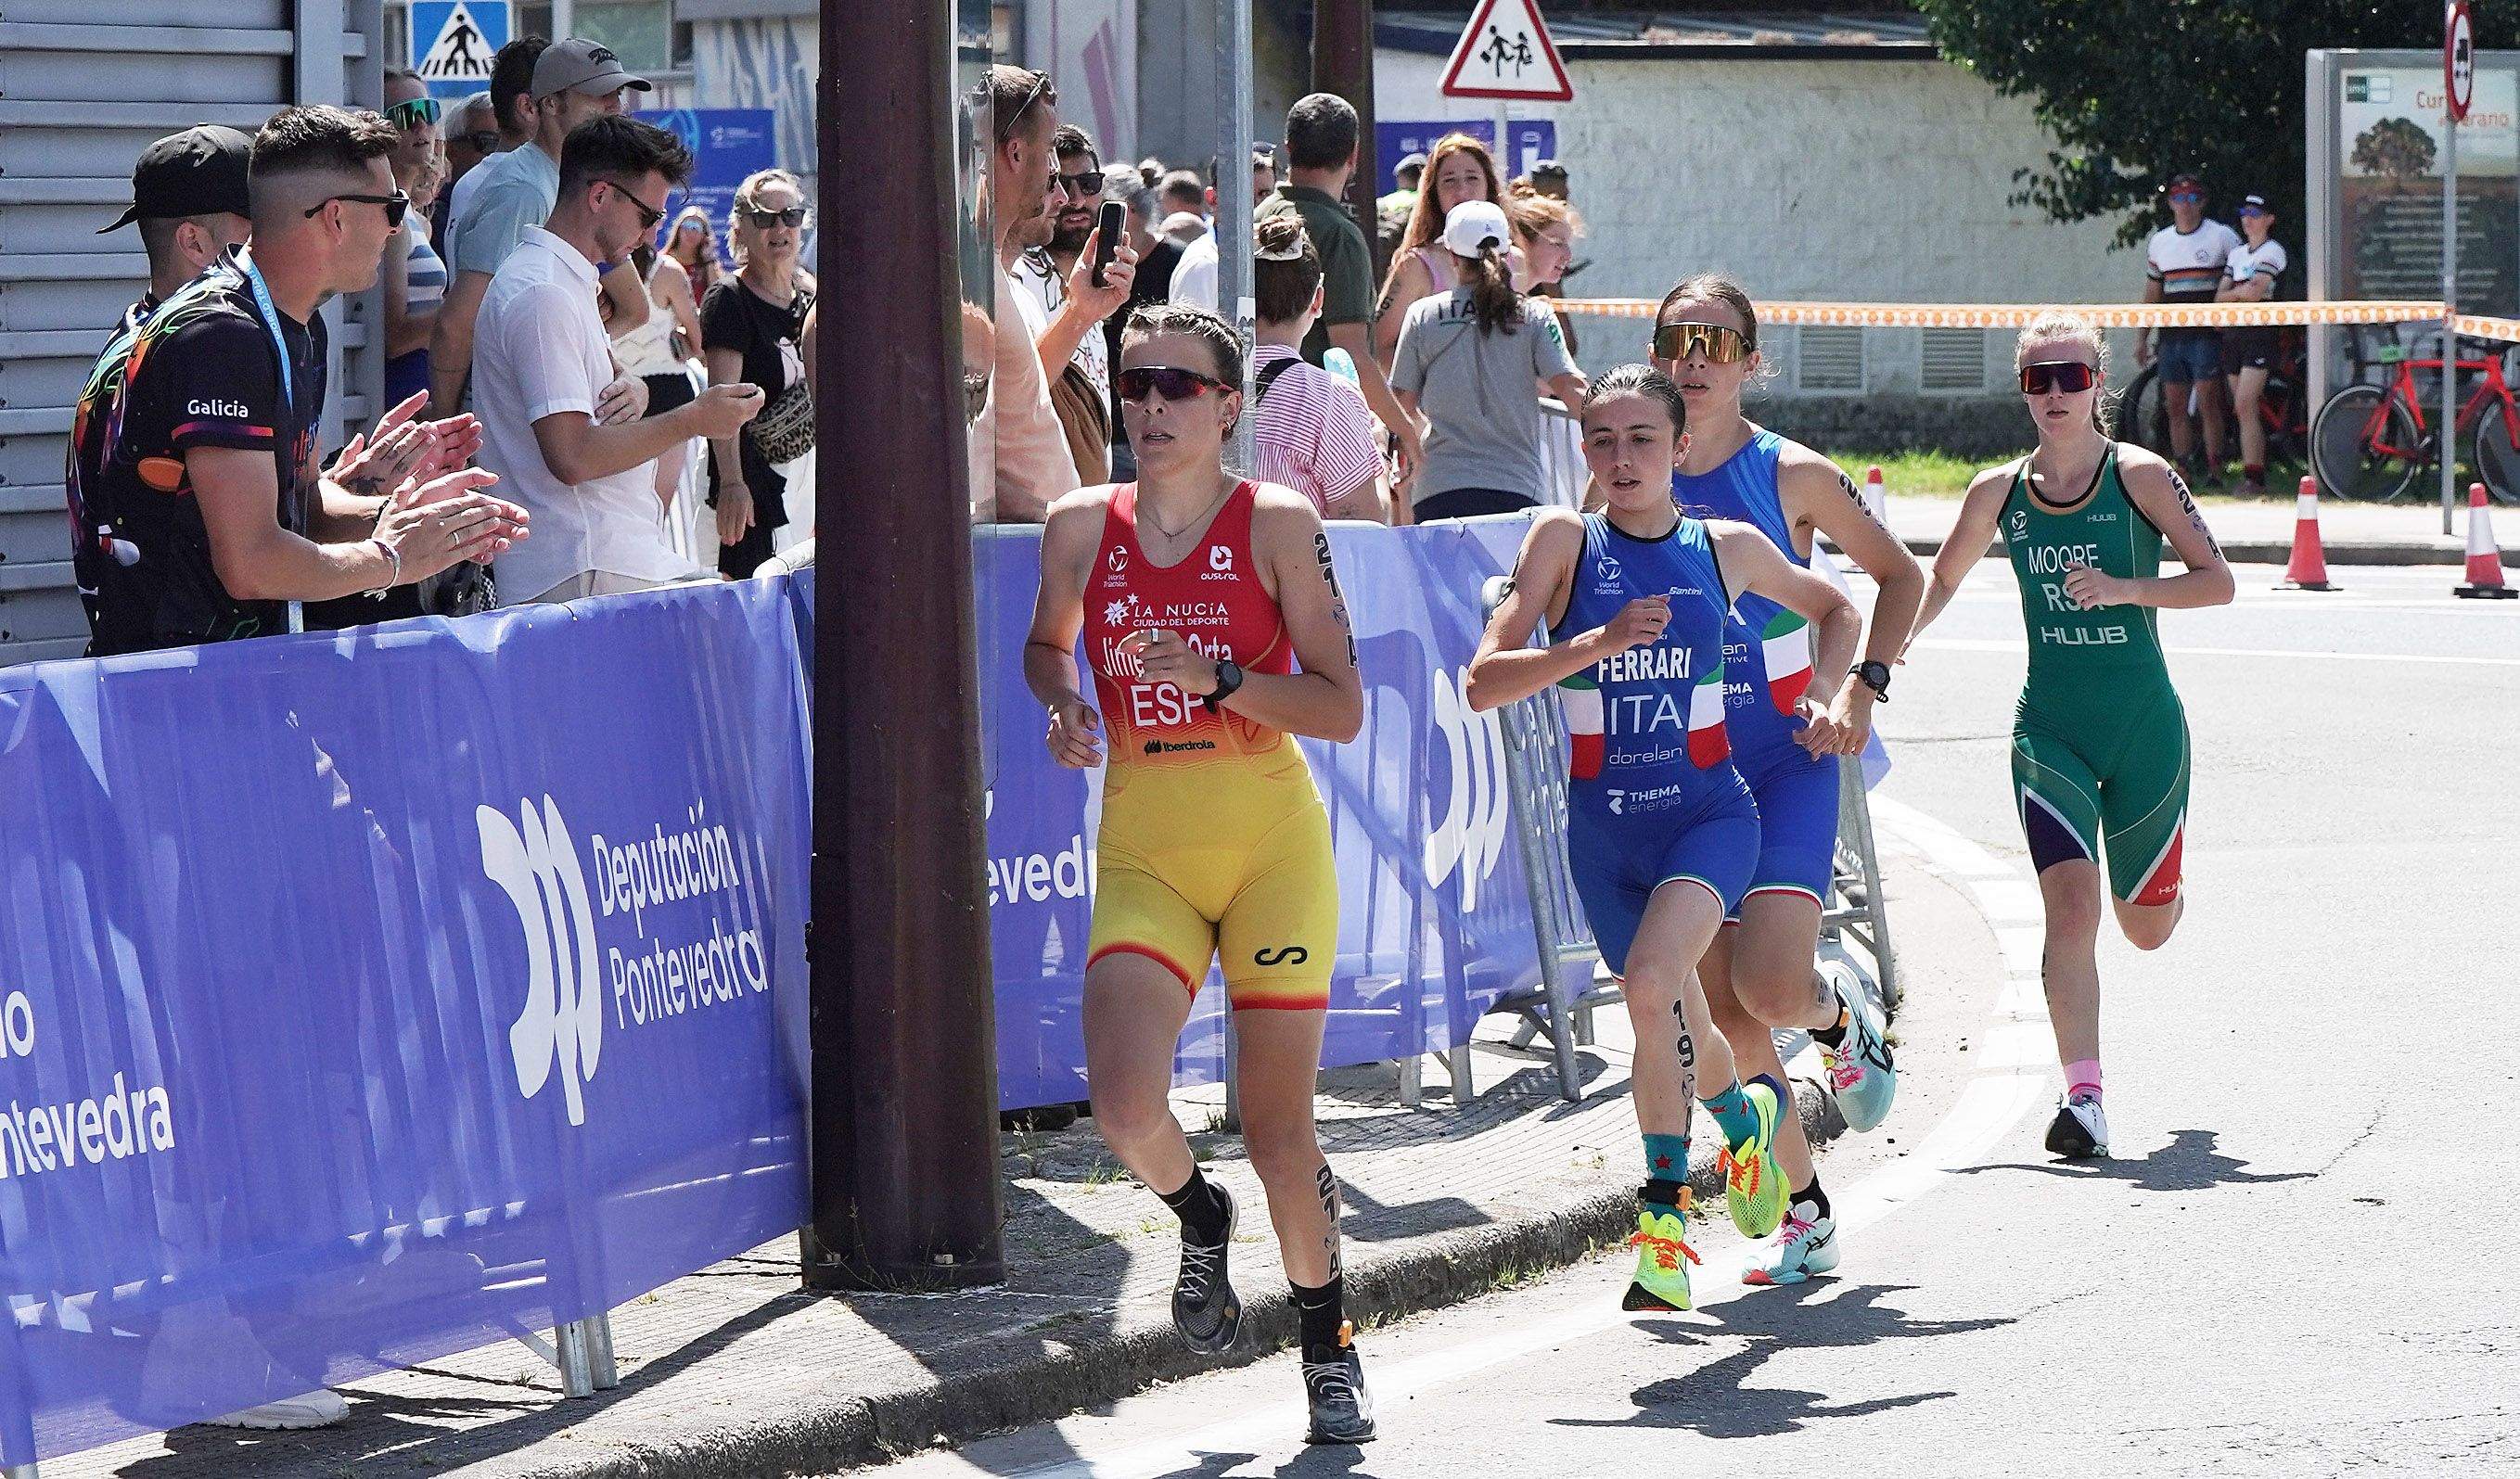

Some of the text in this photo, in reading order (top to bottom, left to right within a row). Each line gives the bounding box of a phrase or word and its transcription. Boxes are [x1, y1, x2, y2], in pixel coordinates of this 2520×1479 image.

[187, 399, 249, 418] Galicia
[1313, 532, 1338, 598] 21
[2028, 543, 2103, 575] MOORE
[1669, 586, 1703, 595] Santini
[2041, 582, 2104, 612] RS
[1132, 617, 1230, 628] CIUDAD DEL DEPORTE
[1134, 605, 1154, 618] LA
[2041, 625, 2129, 645] HUUB
[1597, 647, 1692, 683] FERRARI
[1722, 682, 1753, 695] EMA
[1724, 695, 1755, 708] rgia
[1130, 682, 1205, 727] ESP
[1610, 694, 1683, 735] ITA
[1608, 743, 1682, 765] dorelan
[1629, 784, 1682, 802] THEMA
[1629, 795, 1682, 814] energia
[591, 796, 740, 939] Deputación
[608, 916, 769, 1030] Pontevedra
[1672, 1000, 1695, 1068] 19
[0, 1070, 175, 1179] ntevedra
[1315, 1163, 1337, 1224] 21
